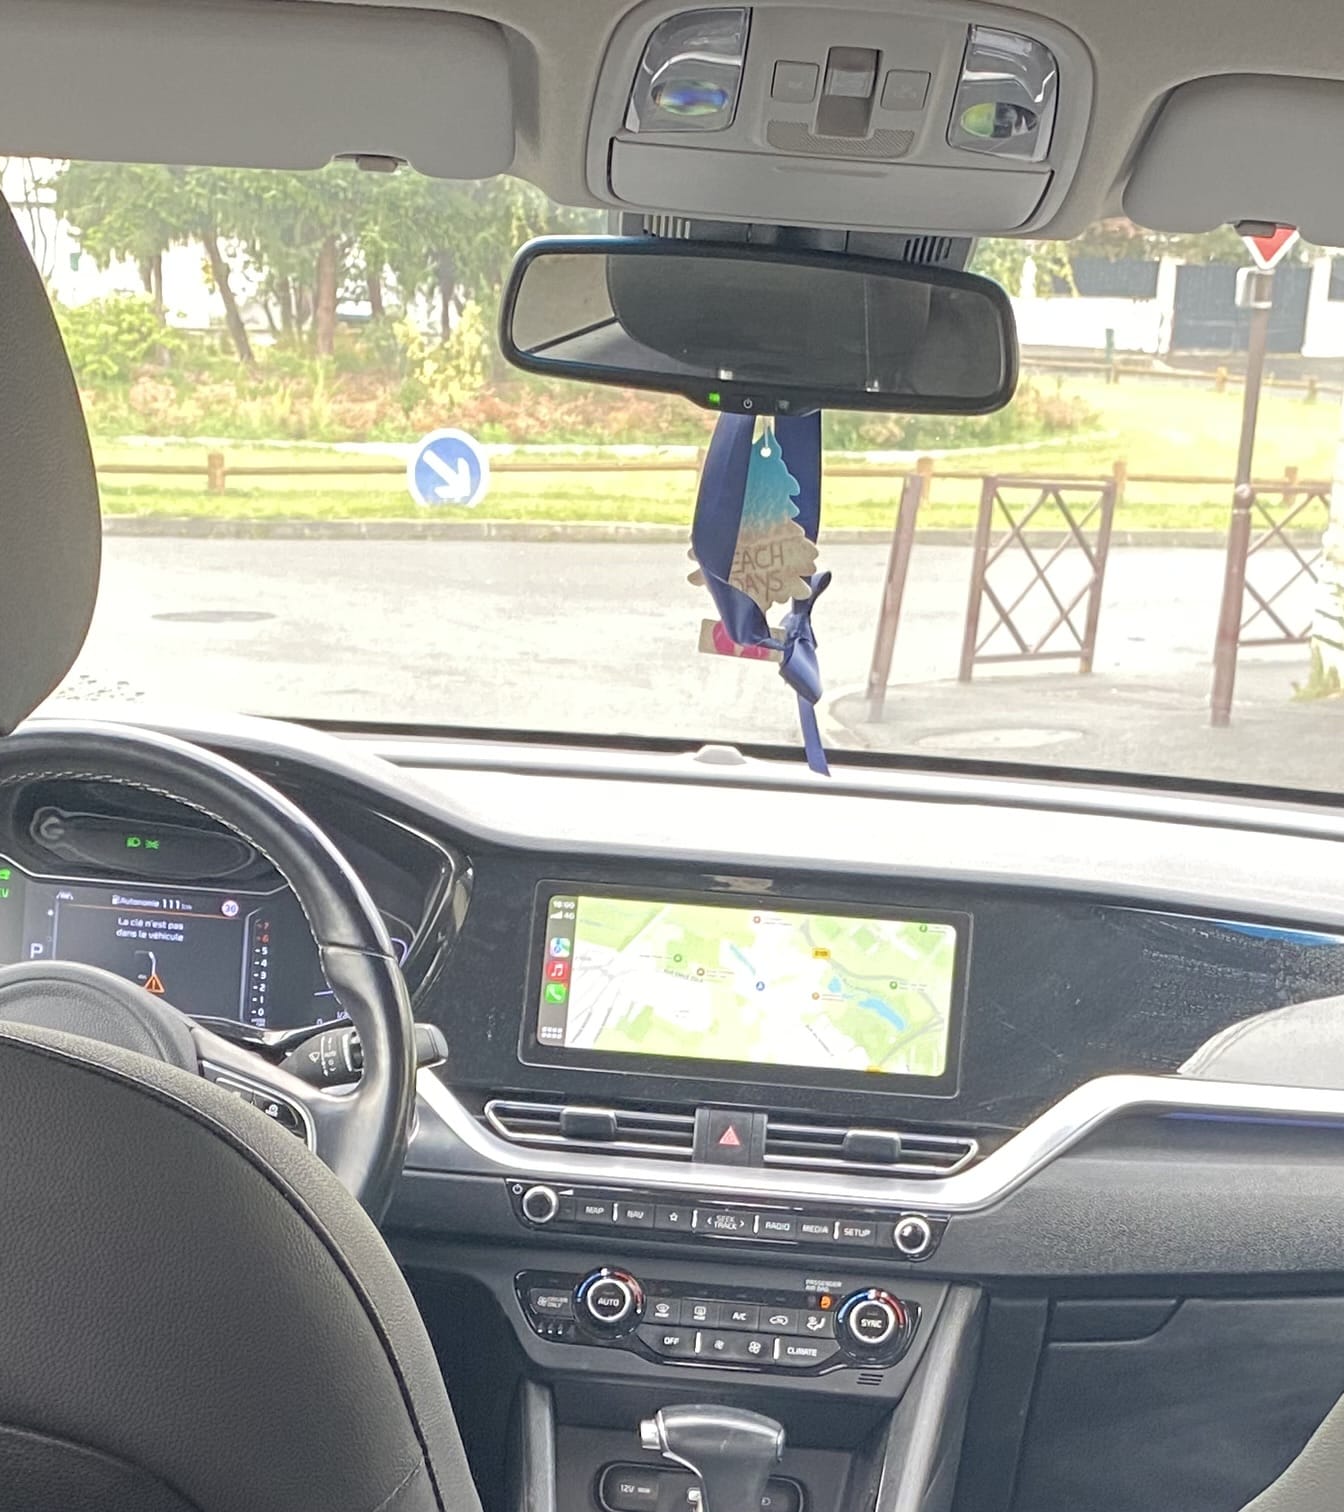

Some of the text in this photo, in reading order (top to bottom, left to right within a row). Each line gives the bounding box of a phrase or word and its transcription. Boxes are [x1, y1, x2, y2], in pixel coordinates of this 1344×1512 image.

[732, 542, 784, 573] EACH
[162, 898, 181, 910] 111
[117, 917, 184, 931] La clé n'est pas
[116, 929, 184, 942] dans le véhicule
[29, 942, 44, 959] P
[261, 946, 268, 955] 5
[260, 959, 268, 967] 4
[260, 971, 267, 980] 3
[259, 983, 266, 992] 2
[257, 1008, 265, 1016] 0
[585, 1206, 604, 1215] MAP
[626, 1209, 644, 1219] NAV
[716, 1215, 735, 1223] SEEK
[714, 1221, 737, 1230] TRACK
[765, 1221, 790, 1231] RADIO
[802, 1224, 828, 1234] MEDIA
[844, 1227, 871, 1237] SETUP
[598, 1298, 619, 1307] AUTO
[732, 1312, 747, 1321] A/C
[861, 1319, 882, 1329] SYNC
[664, 1337, 680, 1346] OFF
[787, 1346, 818, 1357] CLIMATE
[620, 1483, 635, 1493] 12V
